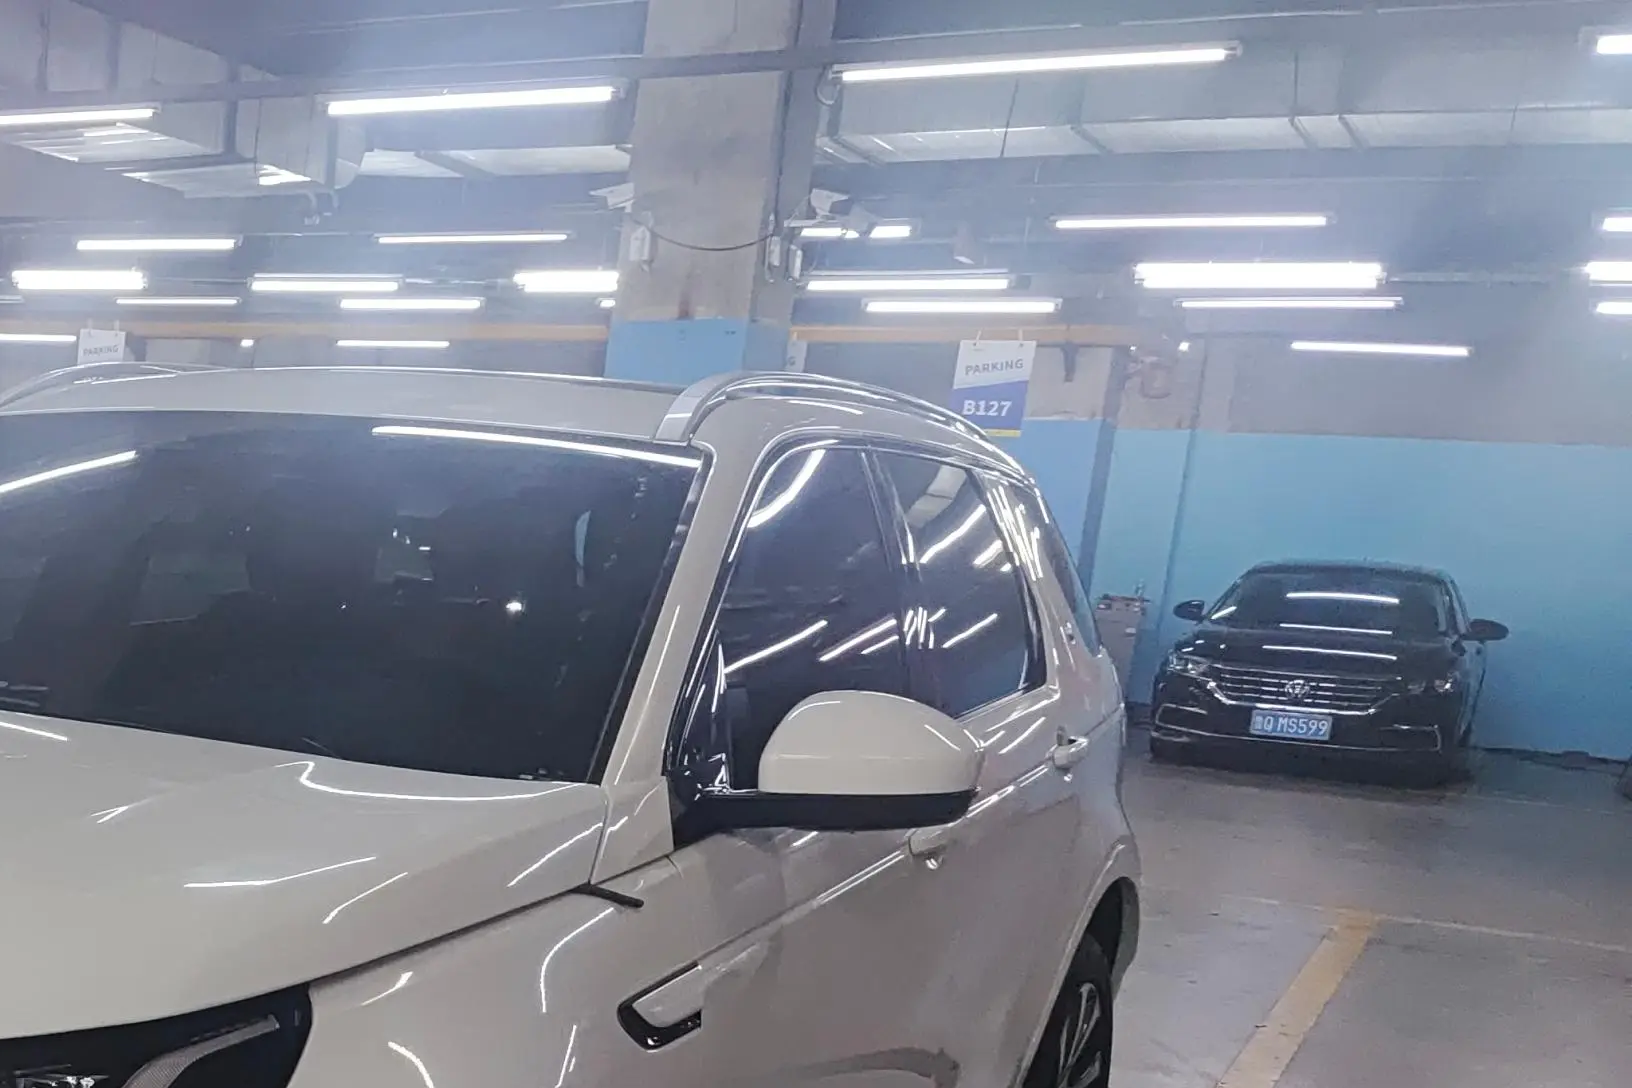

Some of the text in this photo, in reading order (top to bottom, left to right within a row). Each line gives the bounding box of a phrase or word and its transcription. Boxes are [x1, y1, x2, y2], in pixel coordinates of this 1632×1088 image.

[964, 358, 1024, 375] PARKING
[962, 399, 1012, 416] B127
[1277, 716, 1328, 736] MS599
